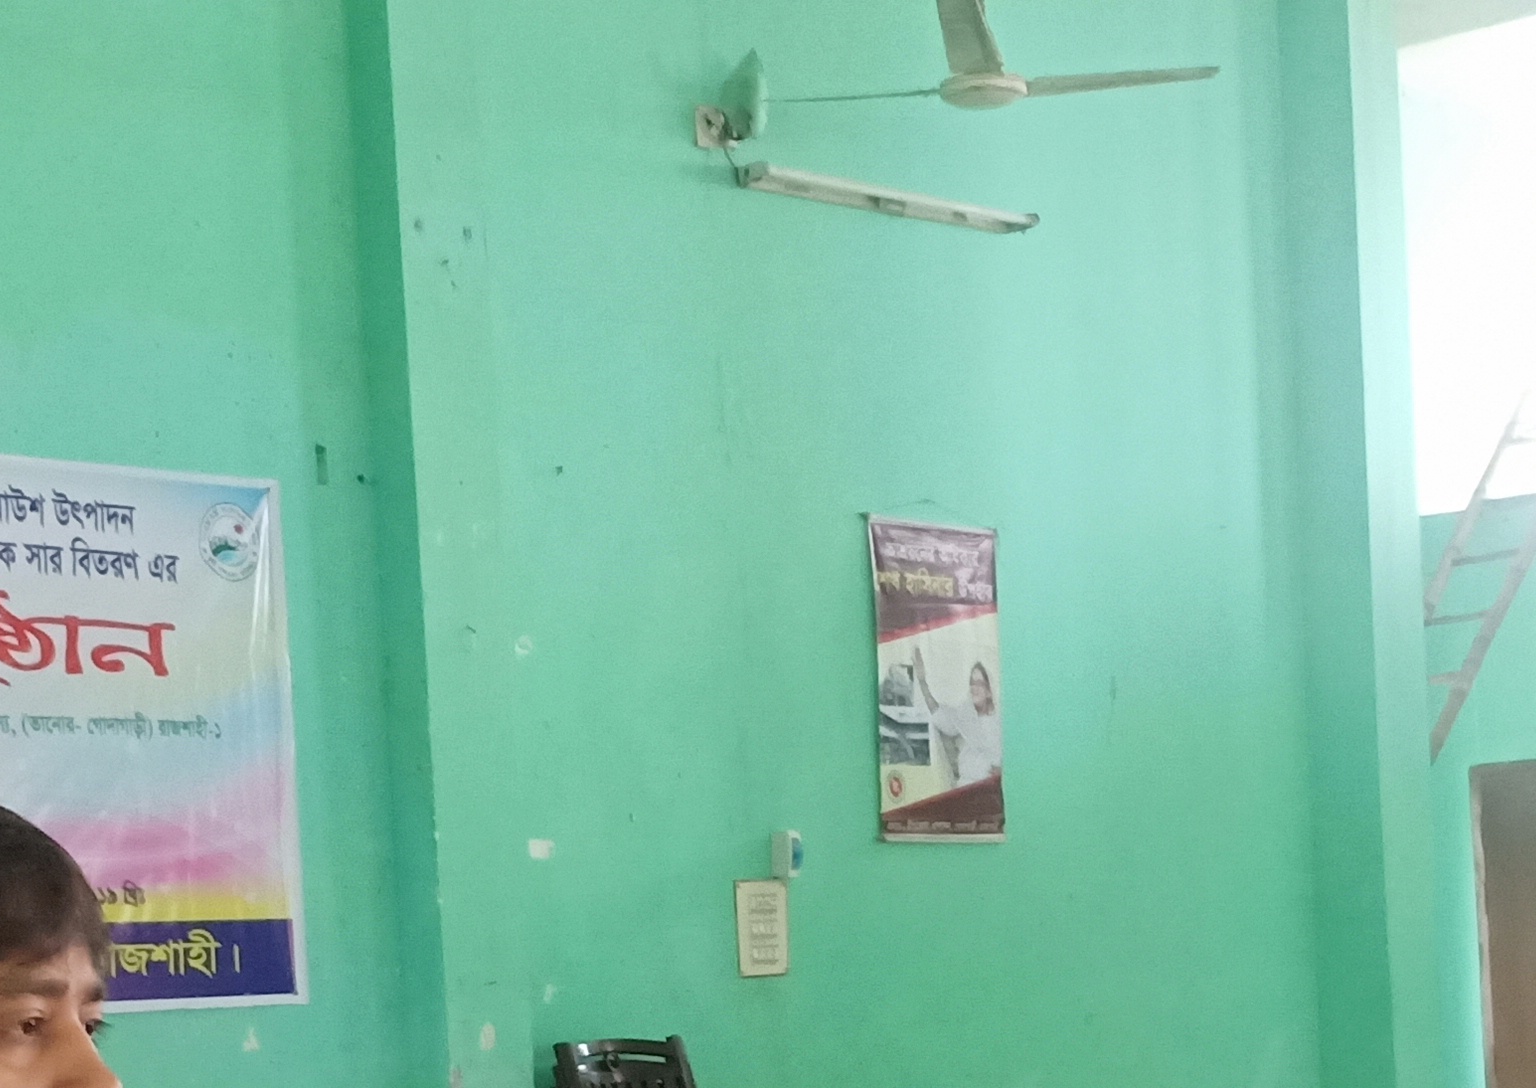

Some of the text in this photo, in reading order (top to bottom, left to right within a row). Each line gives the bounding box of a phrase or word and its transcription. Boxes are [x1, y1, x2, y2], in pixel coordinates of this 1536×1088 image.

[52, 489, 136, 534] উৎপাদন
[24, 541, 63, 575] সার
[70, 537, 139, 580] বিতরণ
[148, 551, 179, 583] এর
